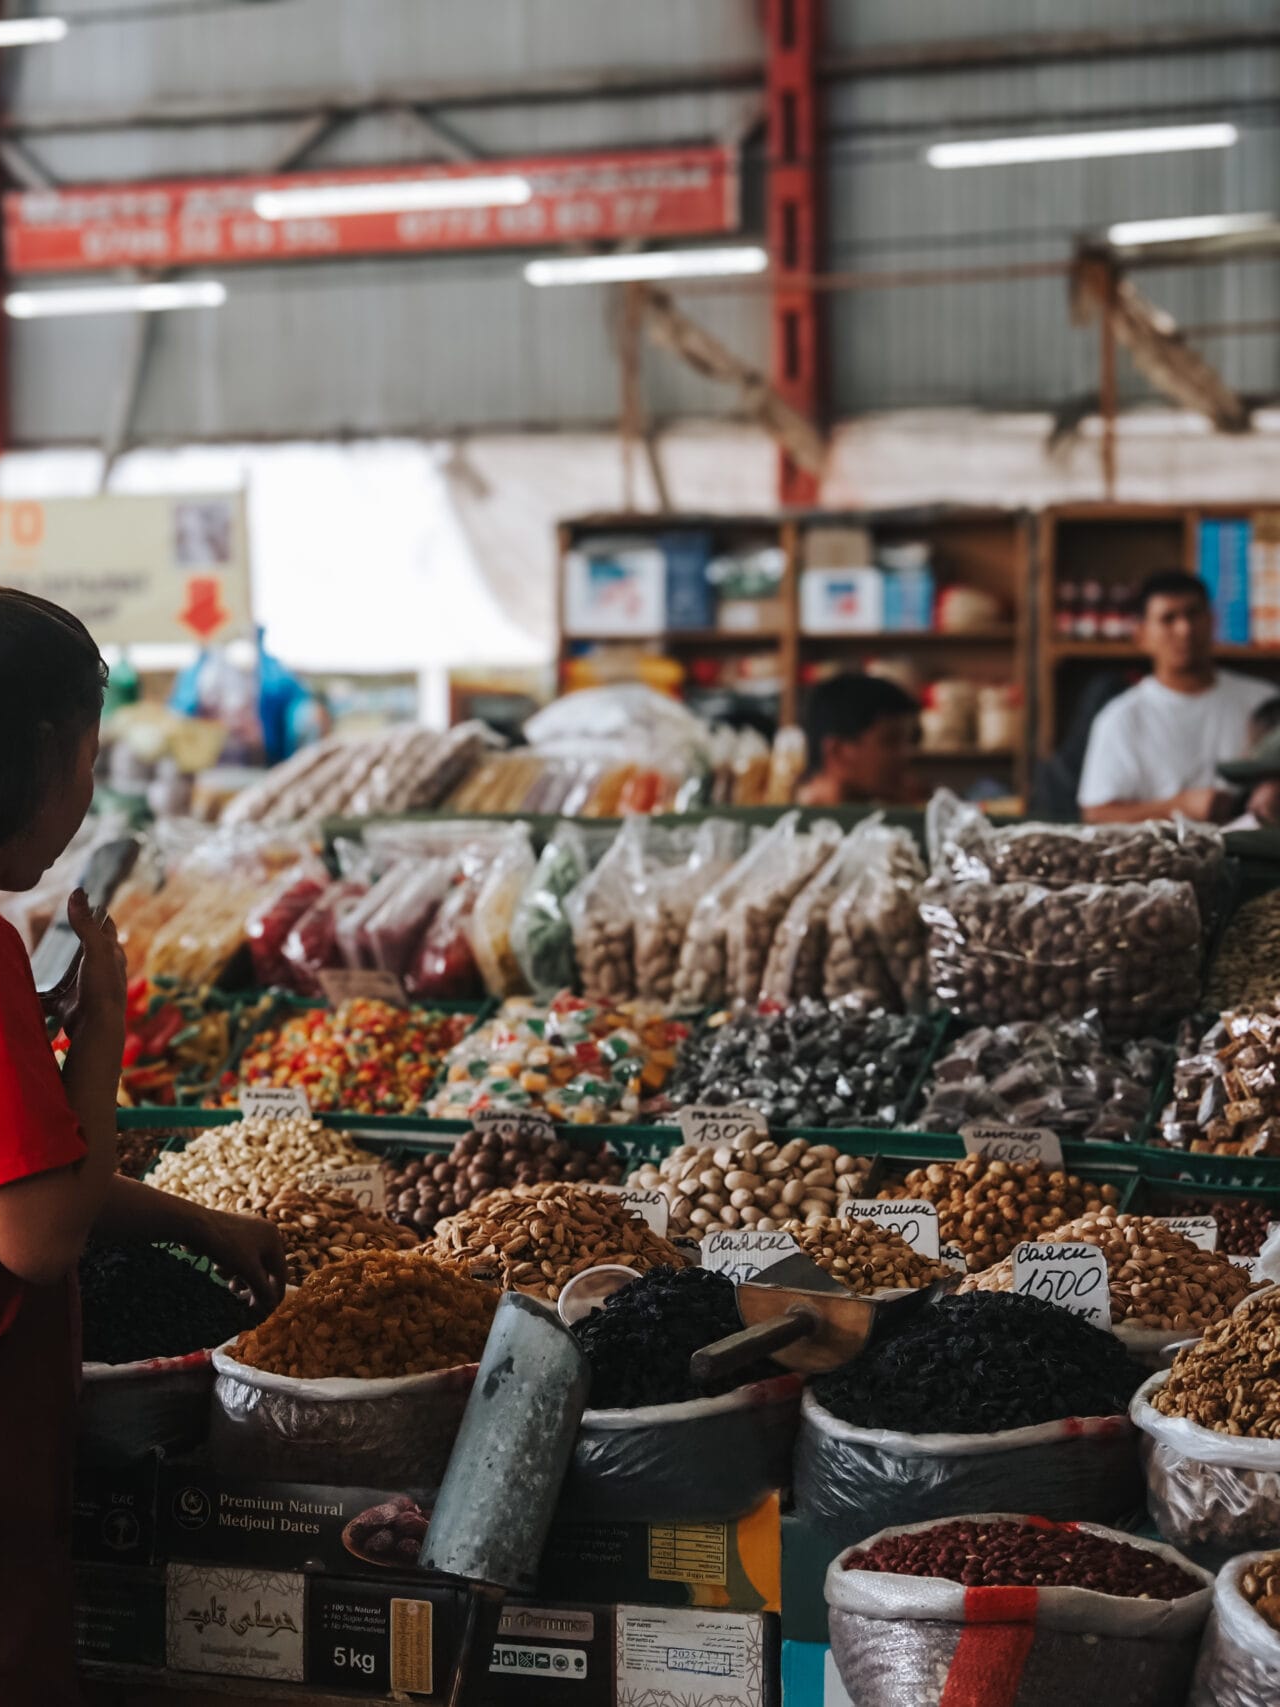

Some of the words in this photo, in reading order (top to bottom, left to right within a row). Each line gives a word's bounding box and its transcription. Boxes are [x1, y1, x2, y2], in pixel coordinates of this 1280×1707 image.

[1018, 1266, 1102, 1301] 1500
[219, 1493, 284, 1511] Premium
[289, 1499, 343, 1516] Natural
[218, 1512, 275, 1531] Medjoul
[280, 1518, 320, 1535] Dates
[355, 1606, 382, 1616] Natural
[363, 1616, 385, 1625] Added
[333, 1647, 346, 1667] 5
[350, 1648, 376, 1674] kg
